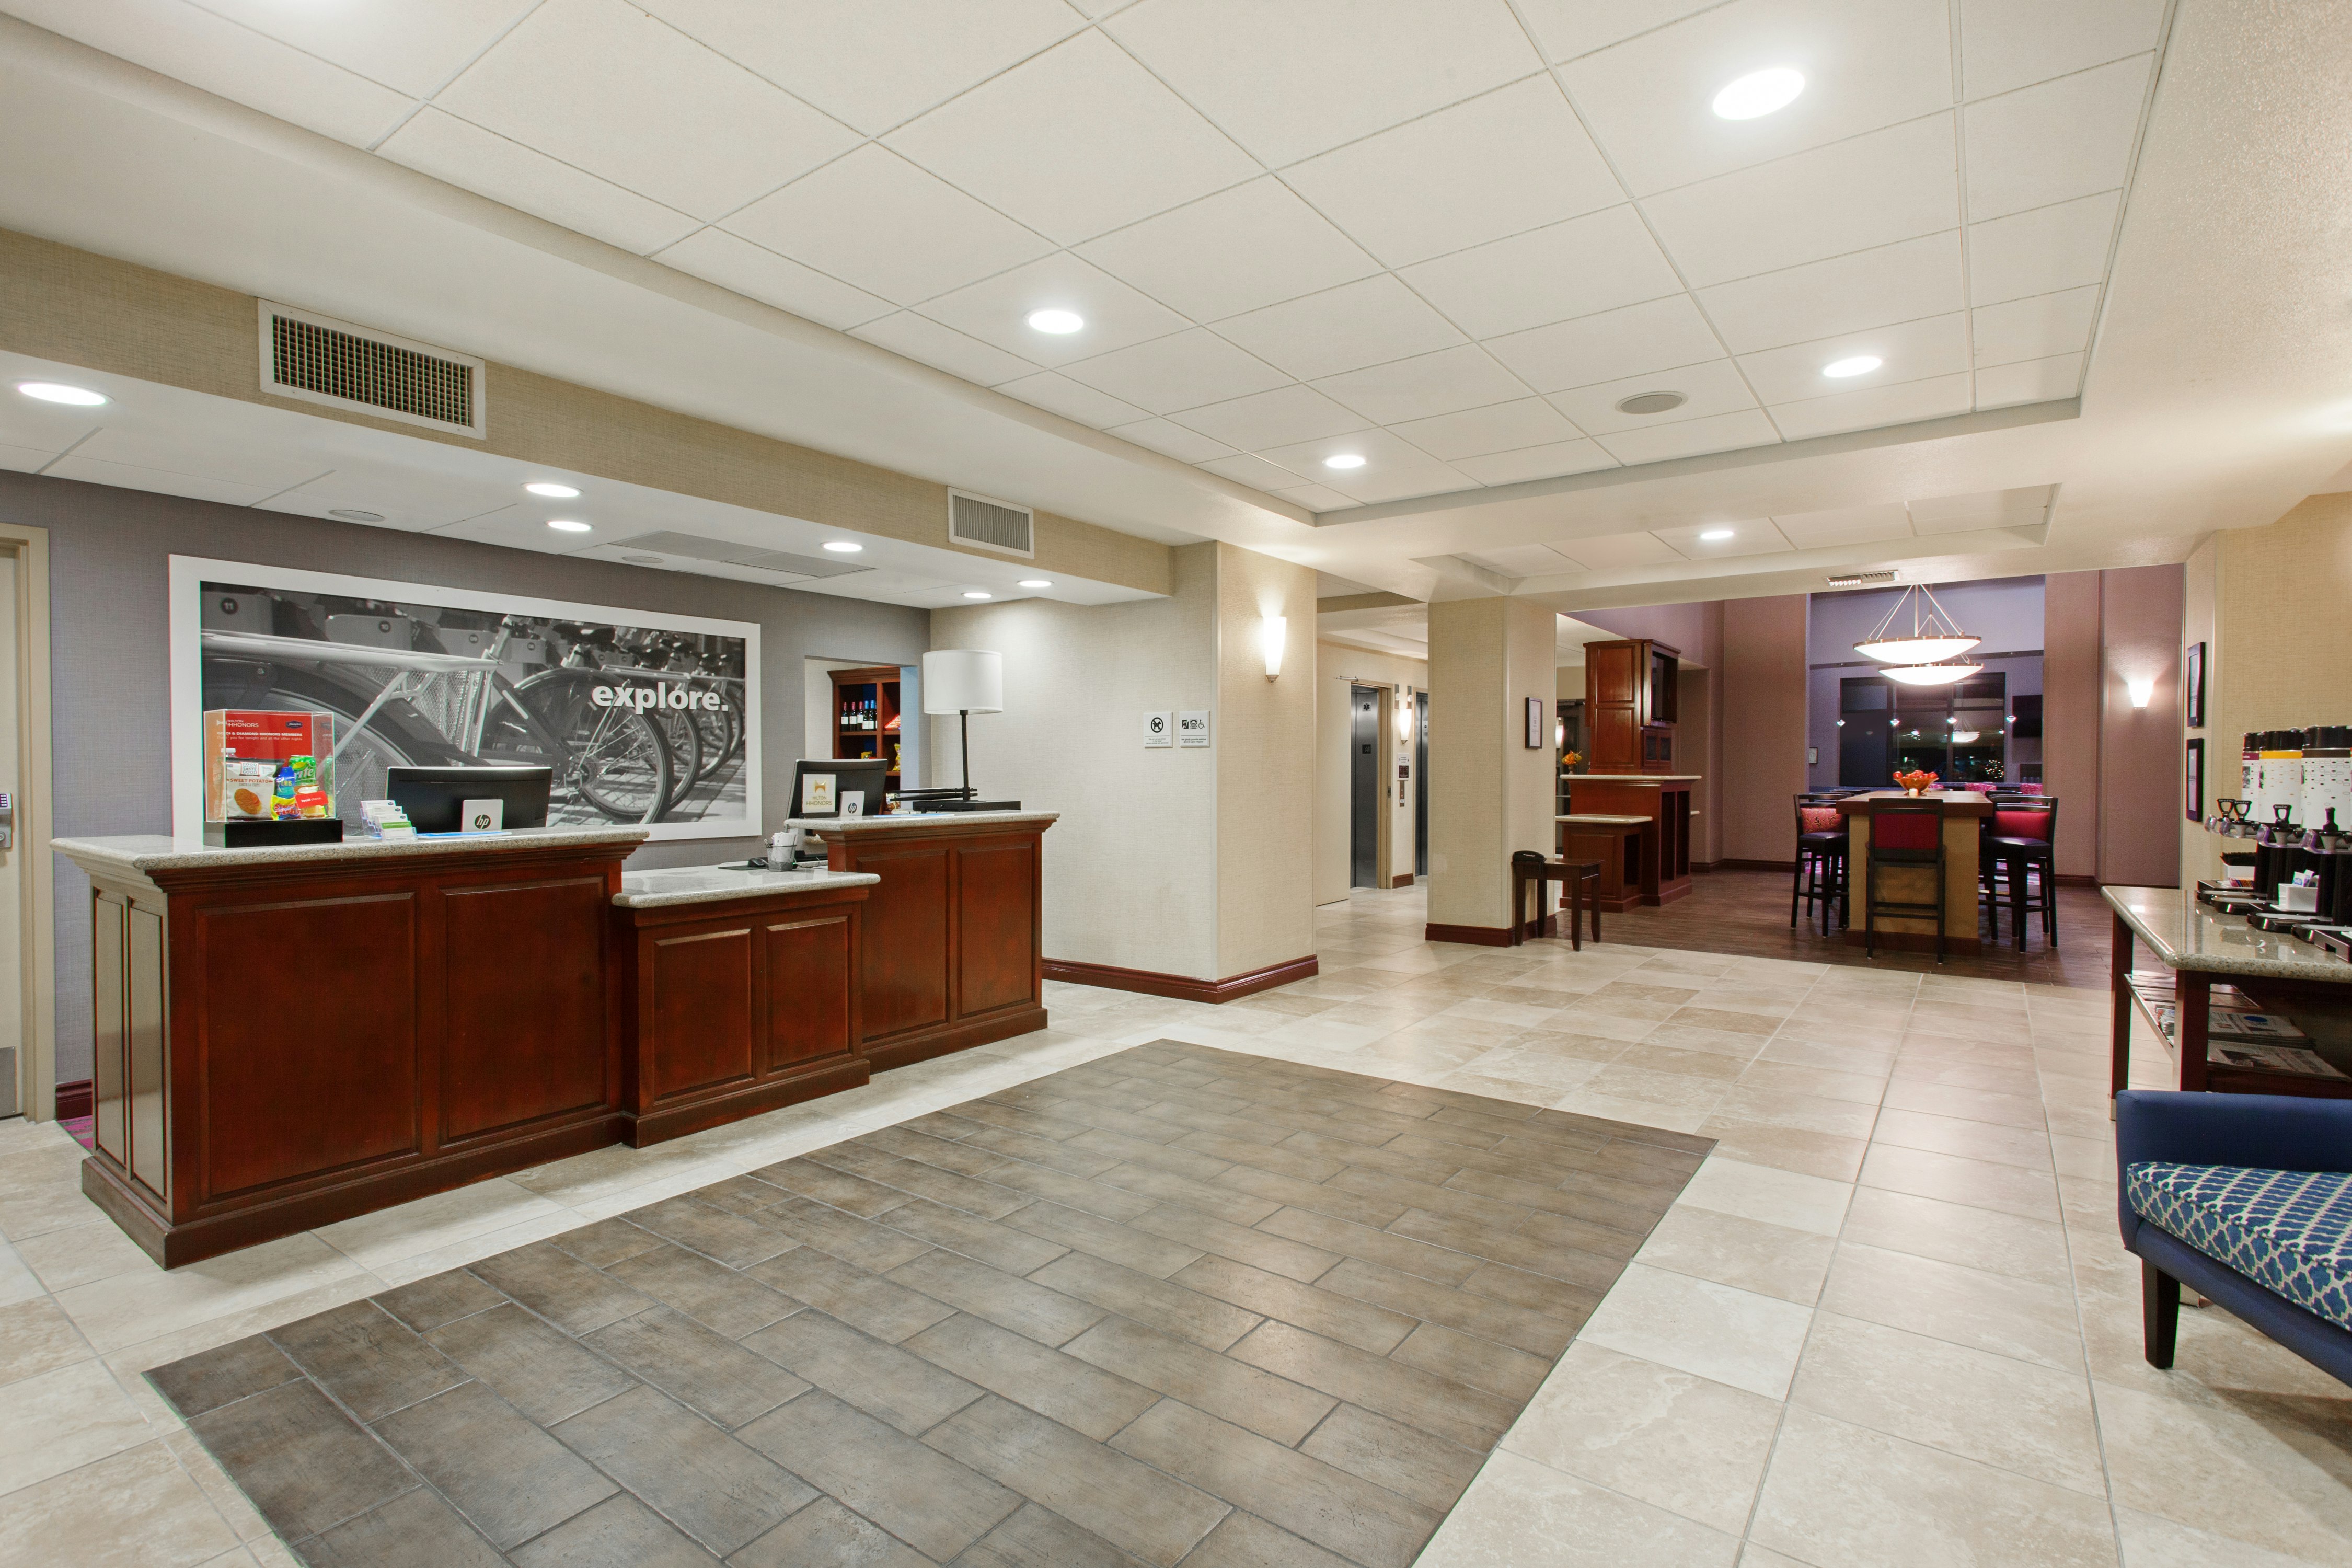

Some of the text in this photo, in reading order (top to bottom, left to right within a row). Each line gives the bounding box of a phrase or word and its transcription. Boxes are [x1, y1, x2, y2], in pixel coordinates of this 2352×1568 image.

[592, 682, 728, 715] explore.
[294, 767, 314, 780] rite
[848, 803, 857, 814] hp
[477, 814, 489, 829] hp
